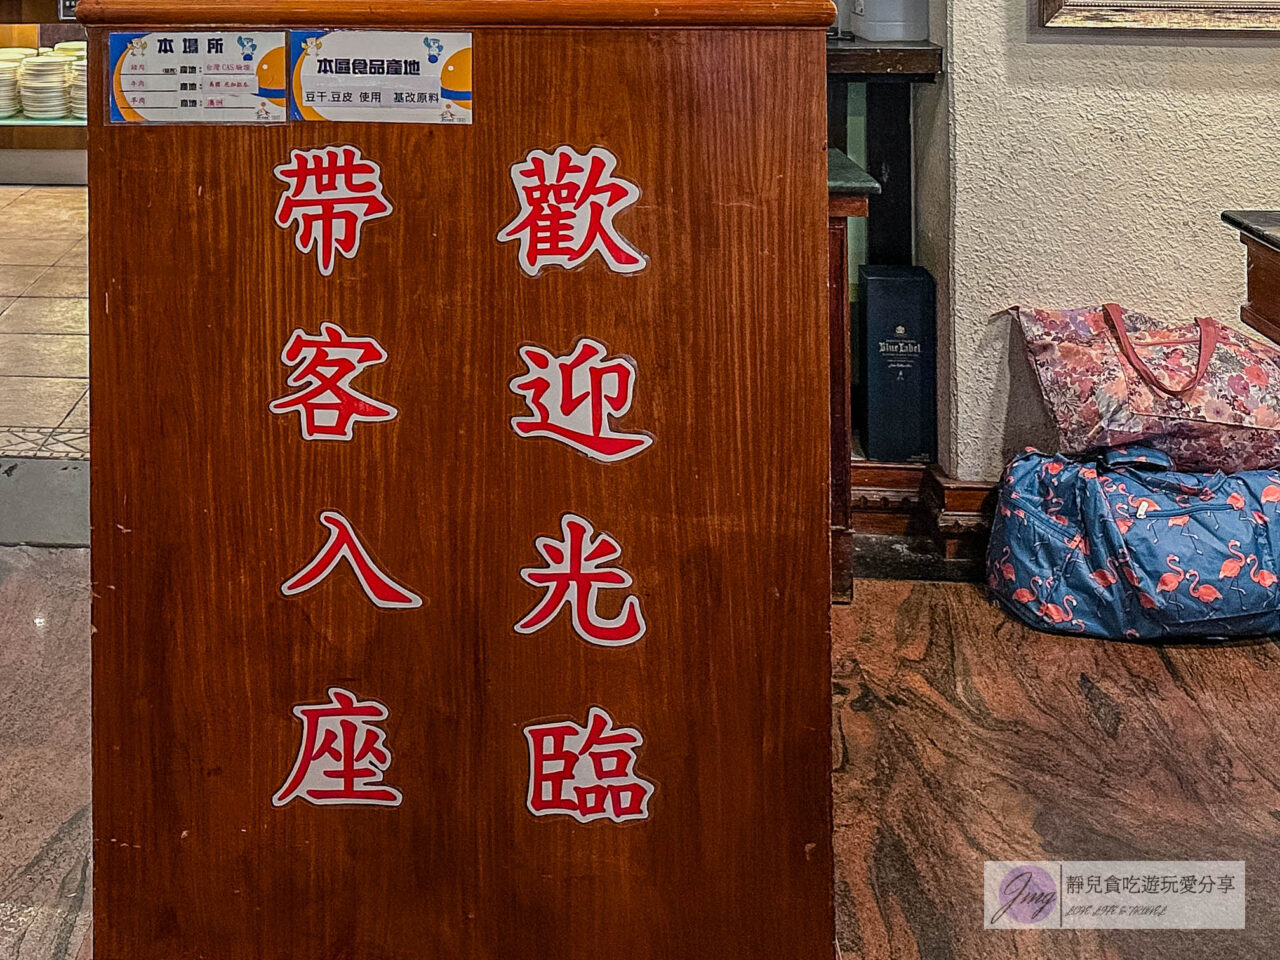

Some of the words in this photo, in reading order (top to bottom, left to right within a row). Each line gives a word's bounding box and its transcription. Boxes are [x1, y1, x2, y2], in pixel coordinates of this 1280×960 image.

[157, 37, 224, 54] 本場所
[317, 58, 421, 76] 本區食品產地
[359, 91, 382, 103] 使用
[393, 92, 440, 104] 基改原料
[879, 342, 899, 353] Blue
[898, 342, 921, 353] Label
[270, 145, 423, 807] 帶客入座
[497, 145, 655, 823] 歡迎光臨
